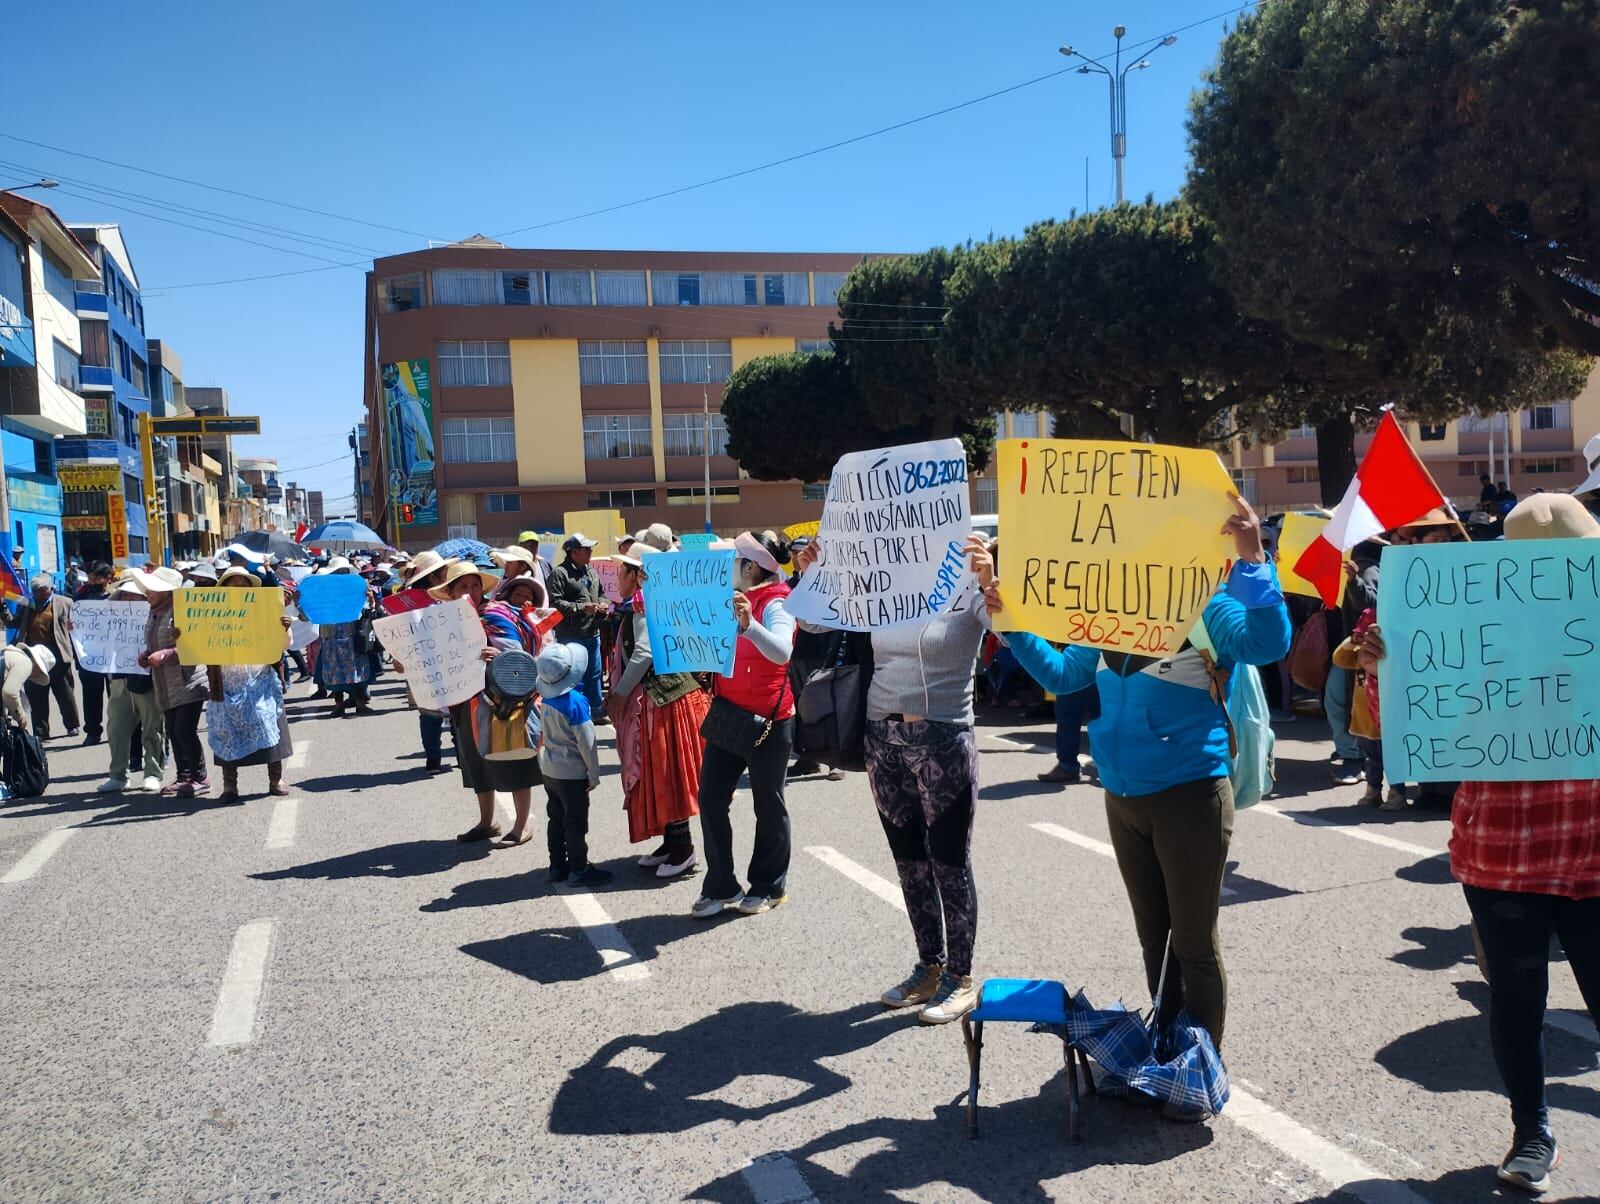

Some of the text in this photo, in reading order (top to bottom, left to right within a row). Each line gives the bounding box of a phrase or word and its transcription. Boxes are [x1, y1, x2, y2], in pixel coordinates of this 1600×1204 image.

[110, 495, 126, 558] FOTOS
[1071, 500, 1117, 544] LA
[874, 536, 909, 565] POR
[847, 570, 891, 597] DAVID
[1405, 555, 1600, 608] QUEREM
[88, 619, 101, 630] de
[457, 608, 473, 620] EL
[448, 631, 471, 644] AL
[1410, 618, 1594, 672] QUE S
[1405, 674, 1572, 720] RESPETE
[1402, 712, 1600, 776] RESOLUCIÓN
